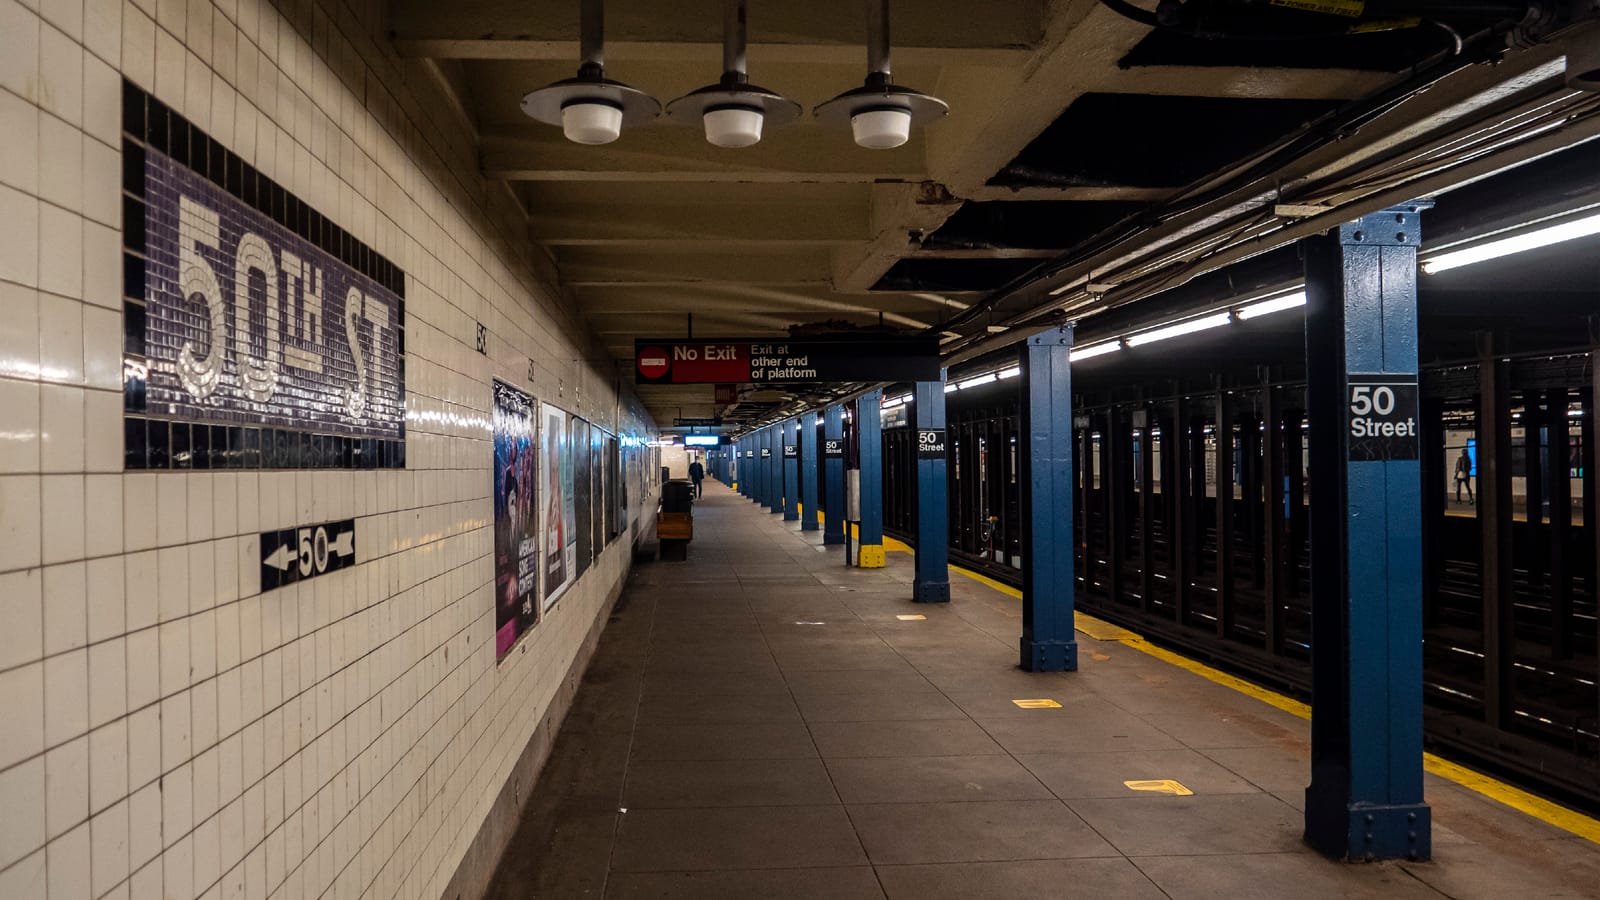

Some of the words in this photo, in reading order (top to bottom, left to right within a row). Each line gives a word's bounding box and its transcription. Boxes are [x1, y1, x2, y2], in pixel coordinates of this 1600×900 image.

[176, 194, 323, 401] 50TH
[344, 286, 389, 419] ST
[674, 345, 698, 361] No
[704, 345, 737, 361] Exit
[751, 344, 773, 355] Exit
[777, 344, 789, 355] at
[751, 356, 782, 367] other
[786, 355, 808, 367] end
[751, 367, 764, 379] of
[768, 367, 817, 380] platform
[1350, 386, 1395, 415] 50
[1351, 417, 1416, 437] Street
[919, 433, 936, 443] 50
[826, 441, 837, 449] 50
[919, 443, 944, 451] Street
[299, 526, 328, 577] 50
